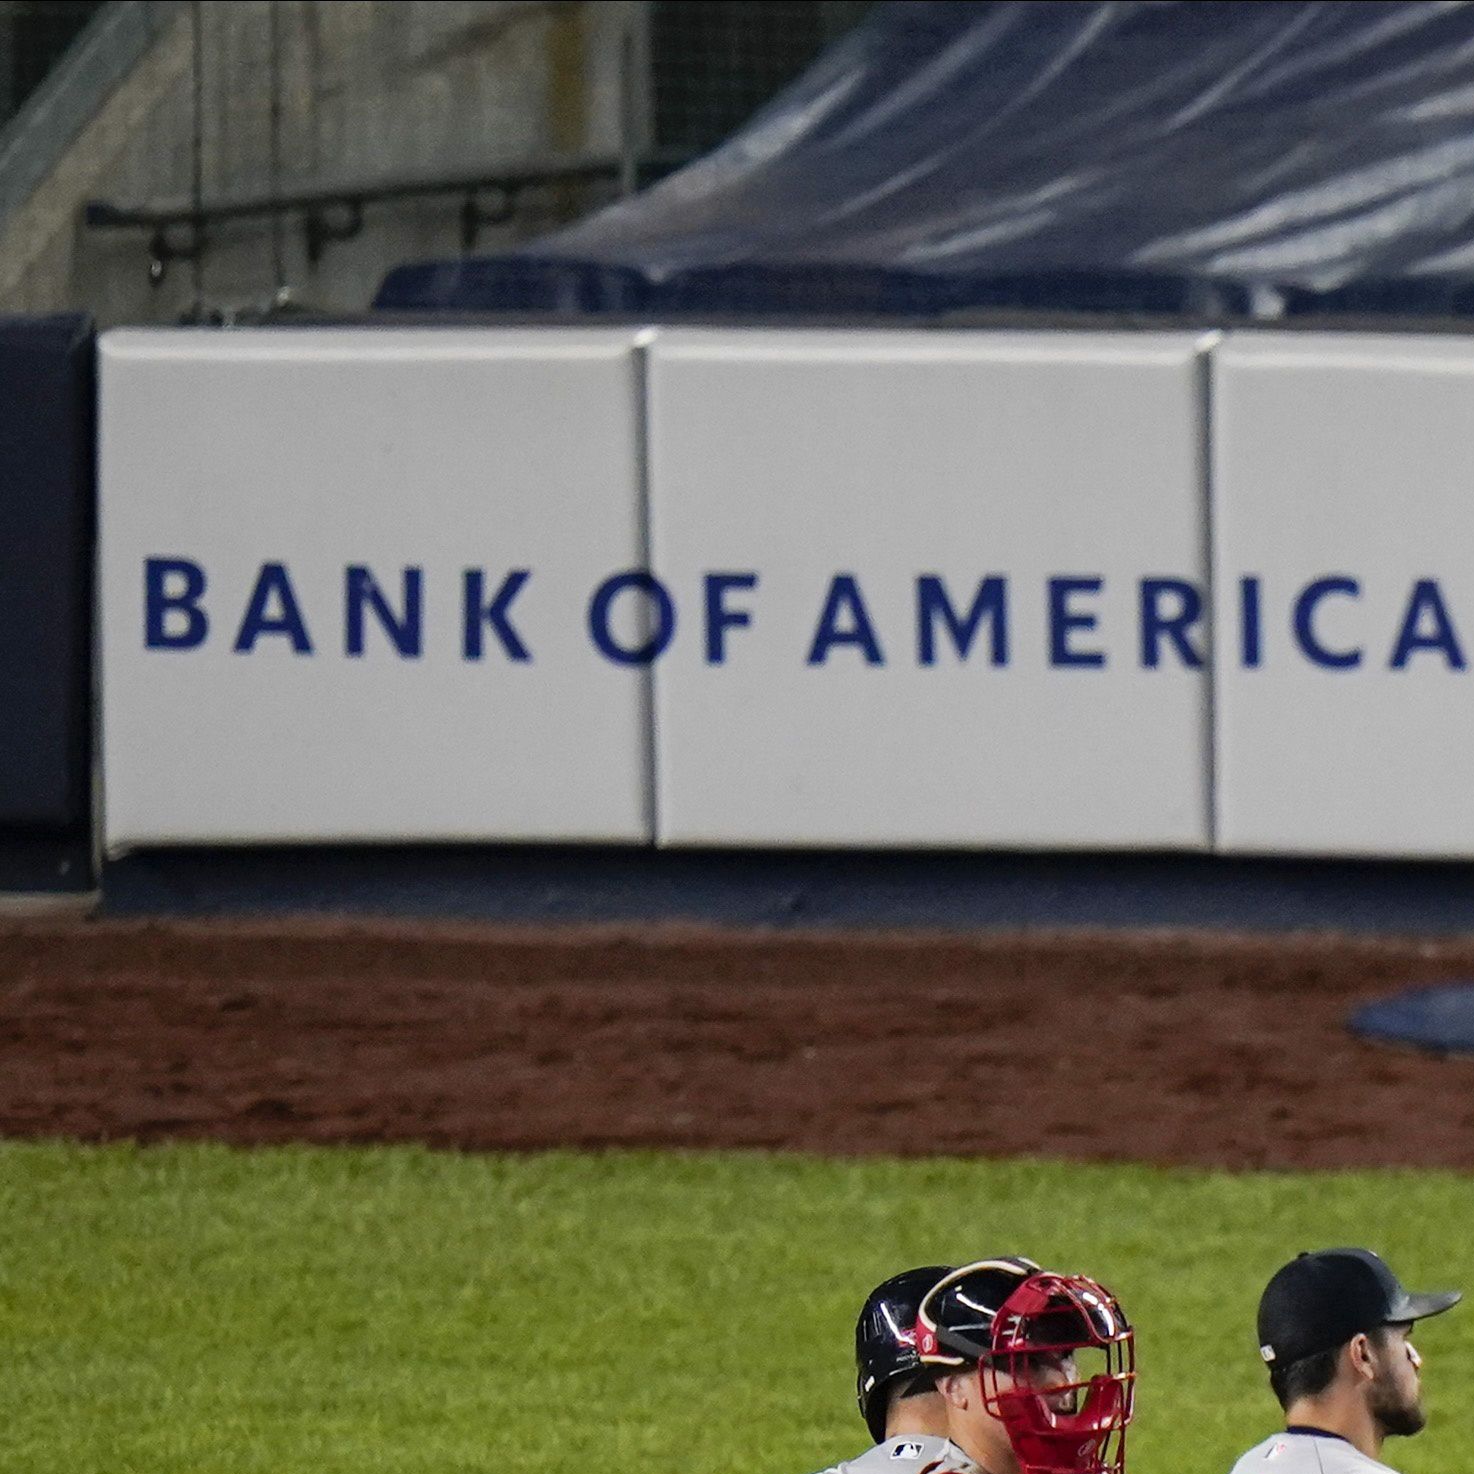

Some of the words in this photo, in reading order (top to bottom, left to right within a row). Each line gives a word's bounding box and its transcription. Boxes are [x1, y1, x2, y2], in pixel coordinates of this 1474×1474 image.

[142, 555, 533, 663] BANK
[586, 569, 760, 668] OF
[806, 573, 1469, 672] AMERICA
